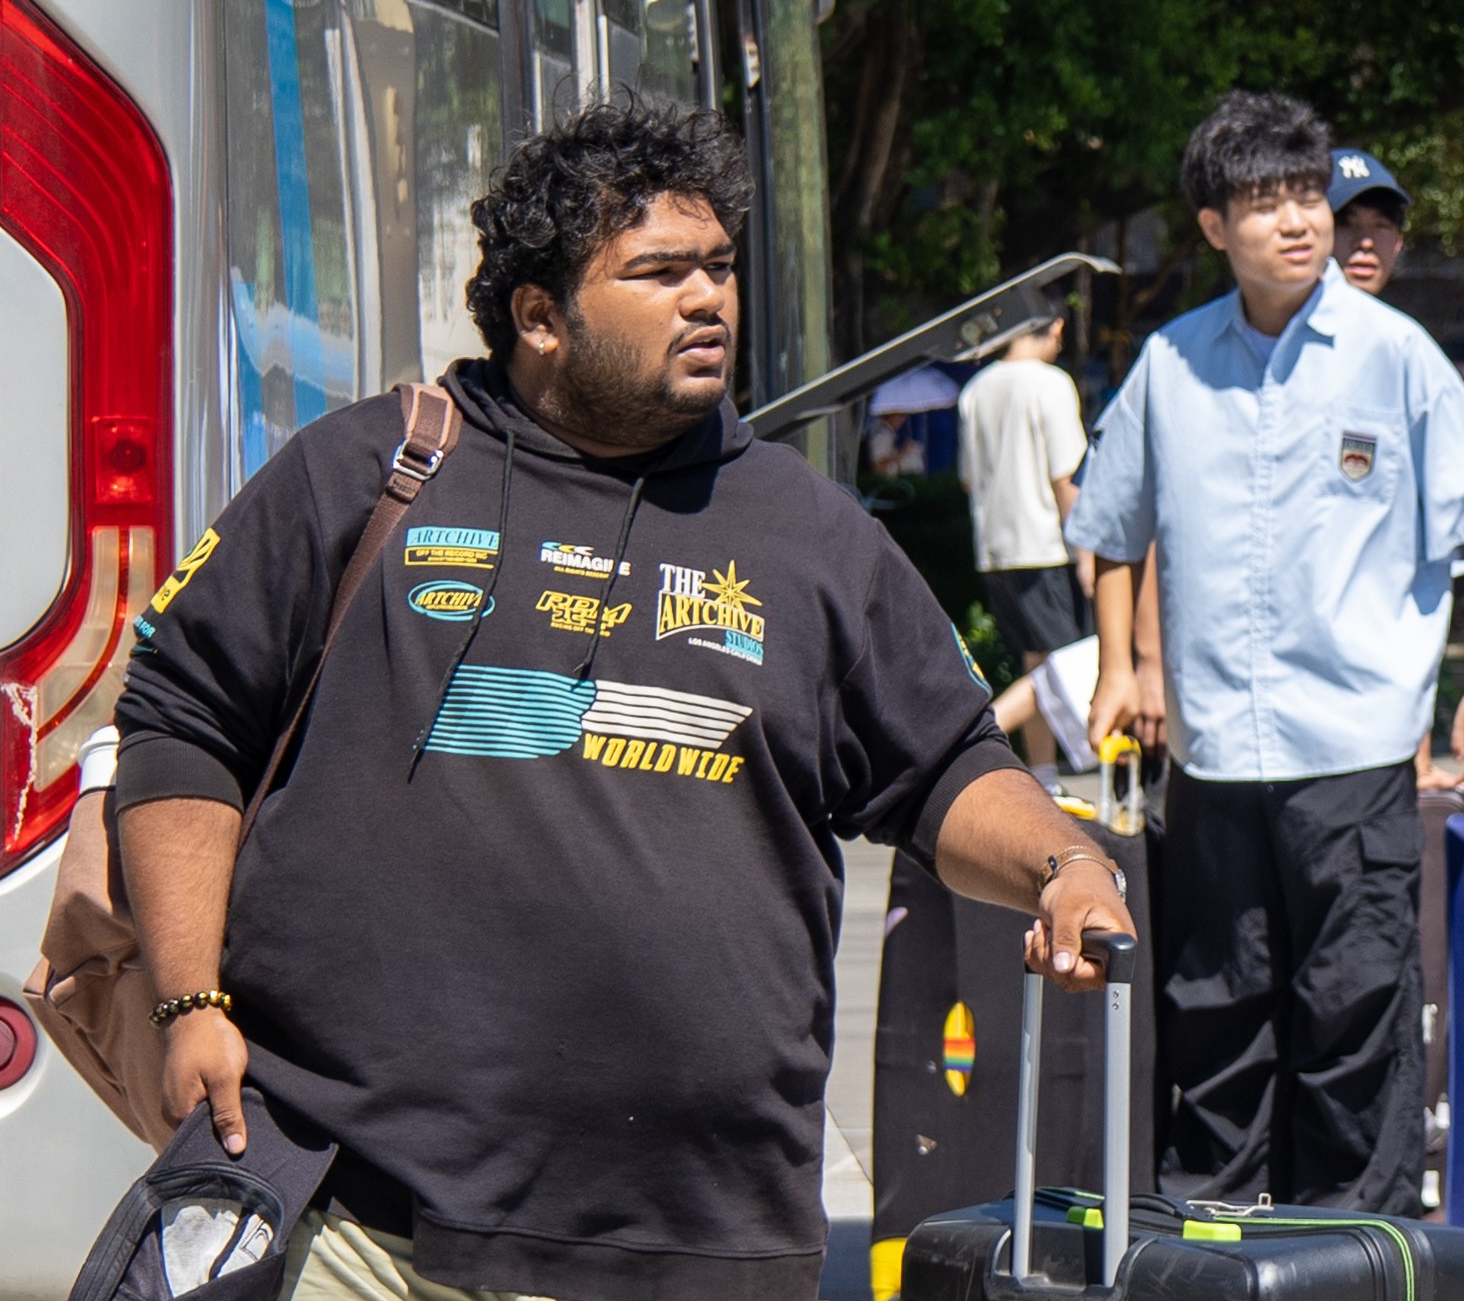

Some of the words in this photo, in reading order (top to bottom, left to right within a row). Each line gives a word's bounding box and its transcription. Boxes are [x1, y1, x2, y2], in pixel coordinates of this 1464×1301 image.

[415, 591, 483, 608] ARTCHIV
[659, 563, 706, 598] THE
[659, 594, 763, 640] ARTCHIVE
[582, 732, 745, 784] WORLDWIDE
